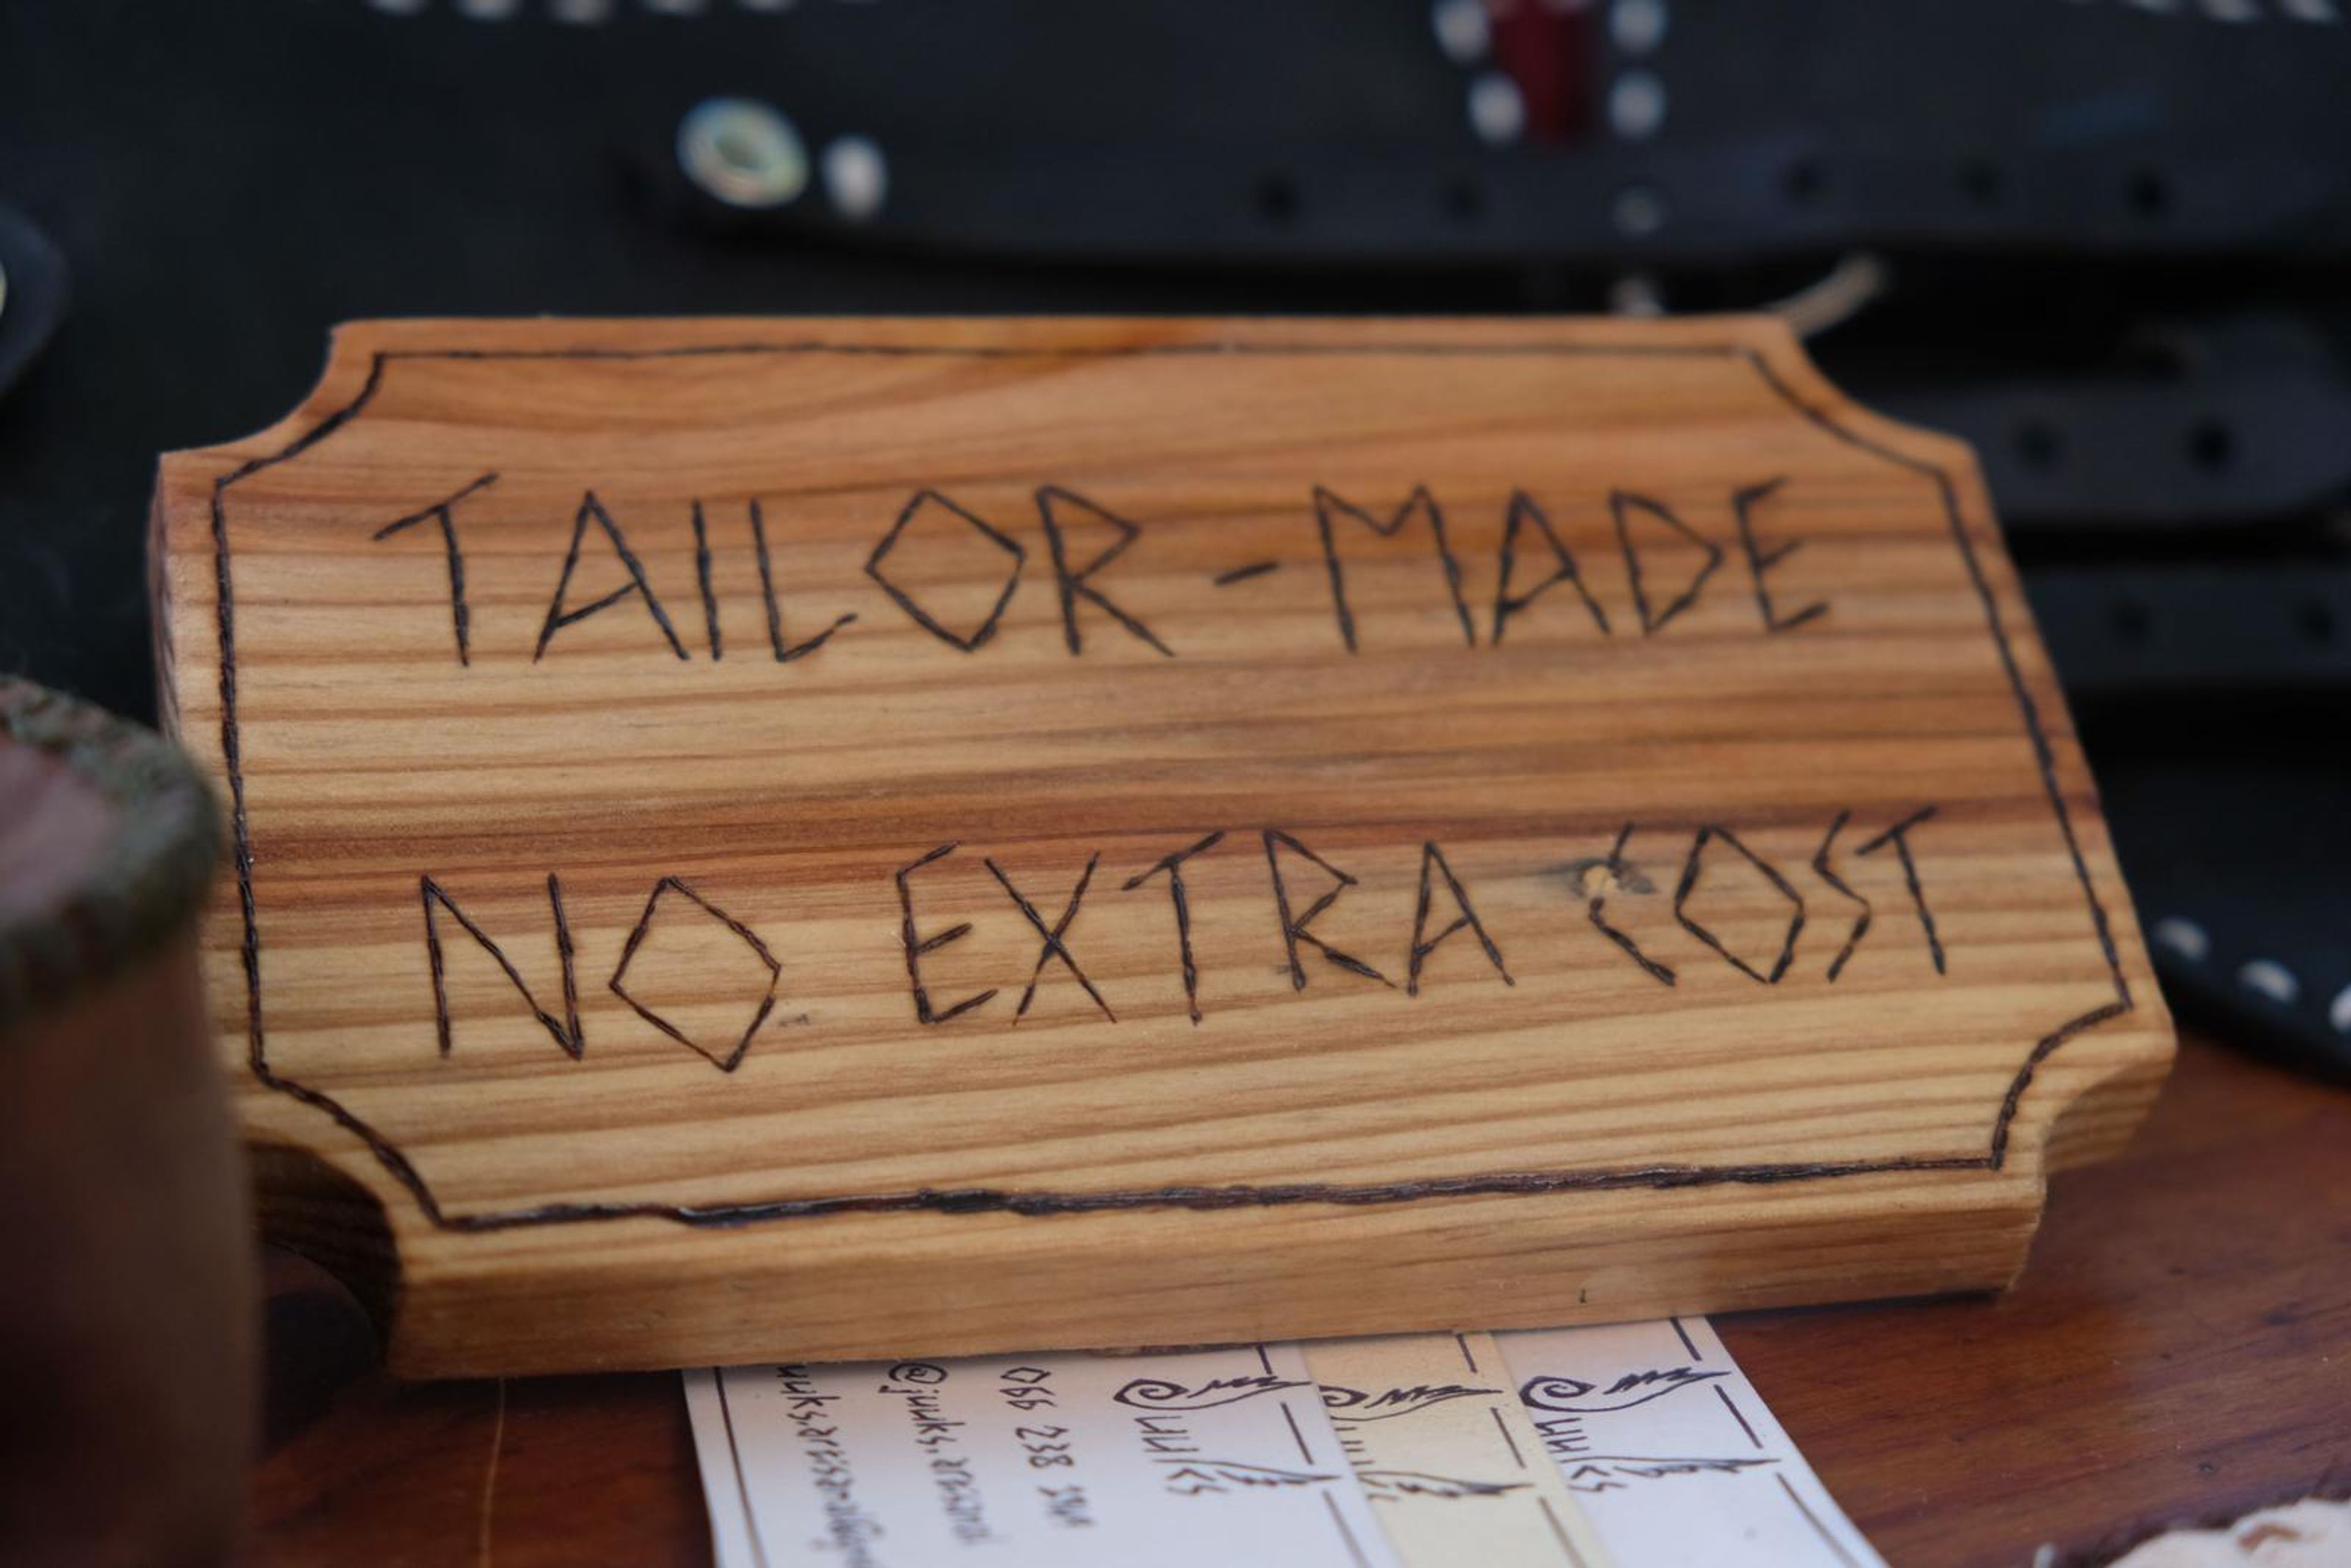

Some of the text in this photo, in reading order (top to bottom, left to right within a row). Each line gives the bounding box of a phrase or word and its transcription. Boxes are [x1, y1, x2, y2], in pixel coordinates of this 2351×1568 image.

[421, 806, 1947, 1073] NO EXTRA COST
[999, 1366, 1057, 1410] 066
[1014, 1425, 1074, 1468] 238
